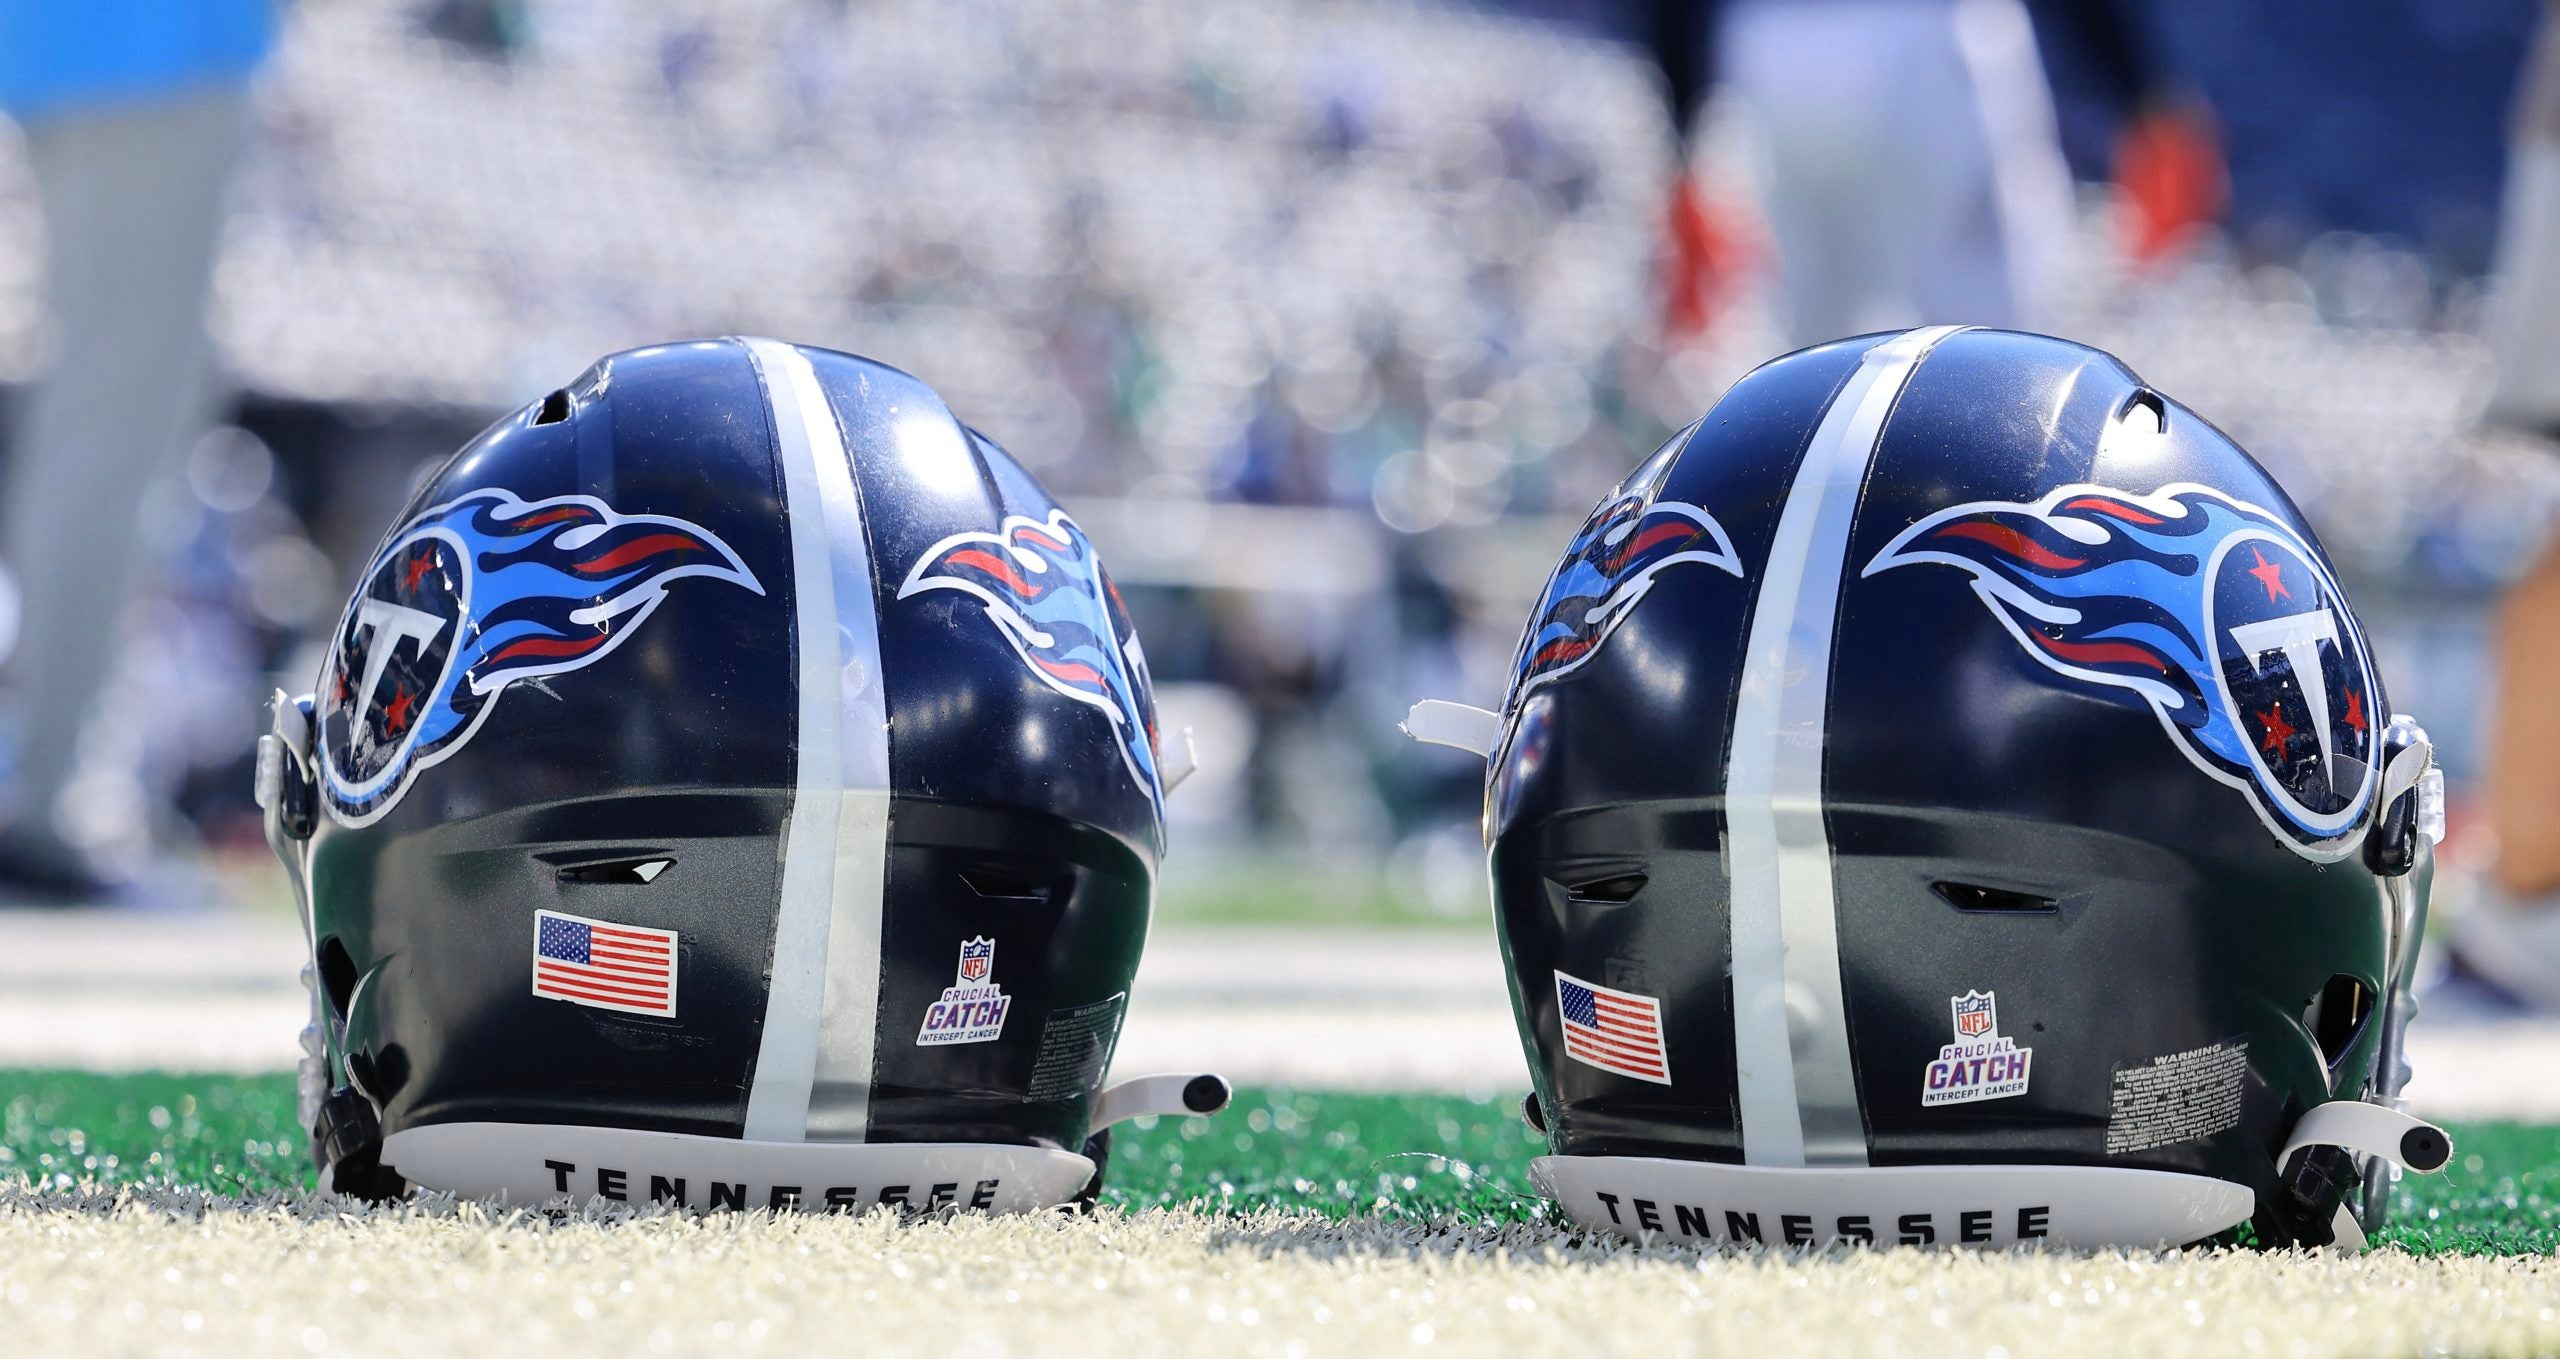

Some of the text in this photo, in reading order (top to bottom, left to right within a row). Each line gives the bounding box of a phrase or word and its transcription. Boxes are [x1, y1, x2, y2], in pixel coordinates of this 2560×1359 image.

[964, 959, 985, 978] NFL
[943, 987, 997, 1002] CRUCIAL
[927, 998, 1007, 1030] CATCH
[1960, 1012, 1990, 1033] NFL
[920, 1028, 999, 1041] INTERCEPT CANCER
[1943, 1040, 2012, 1060] CRUCIAL
[2154, 1043, 2222, 1066] WARNING
[1928, 1051, 2027, 1090] CATCH
[1925, 1082, 2024, 1102] INTERCEPT CANCER
[545, 1159, 1000, 1213] TENNESSEE
[1597, 1191, 2050, 1247] TENNESSEE
